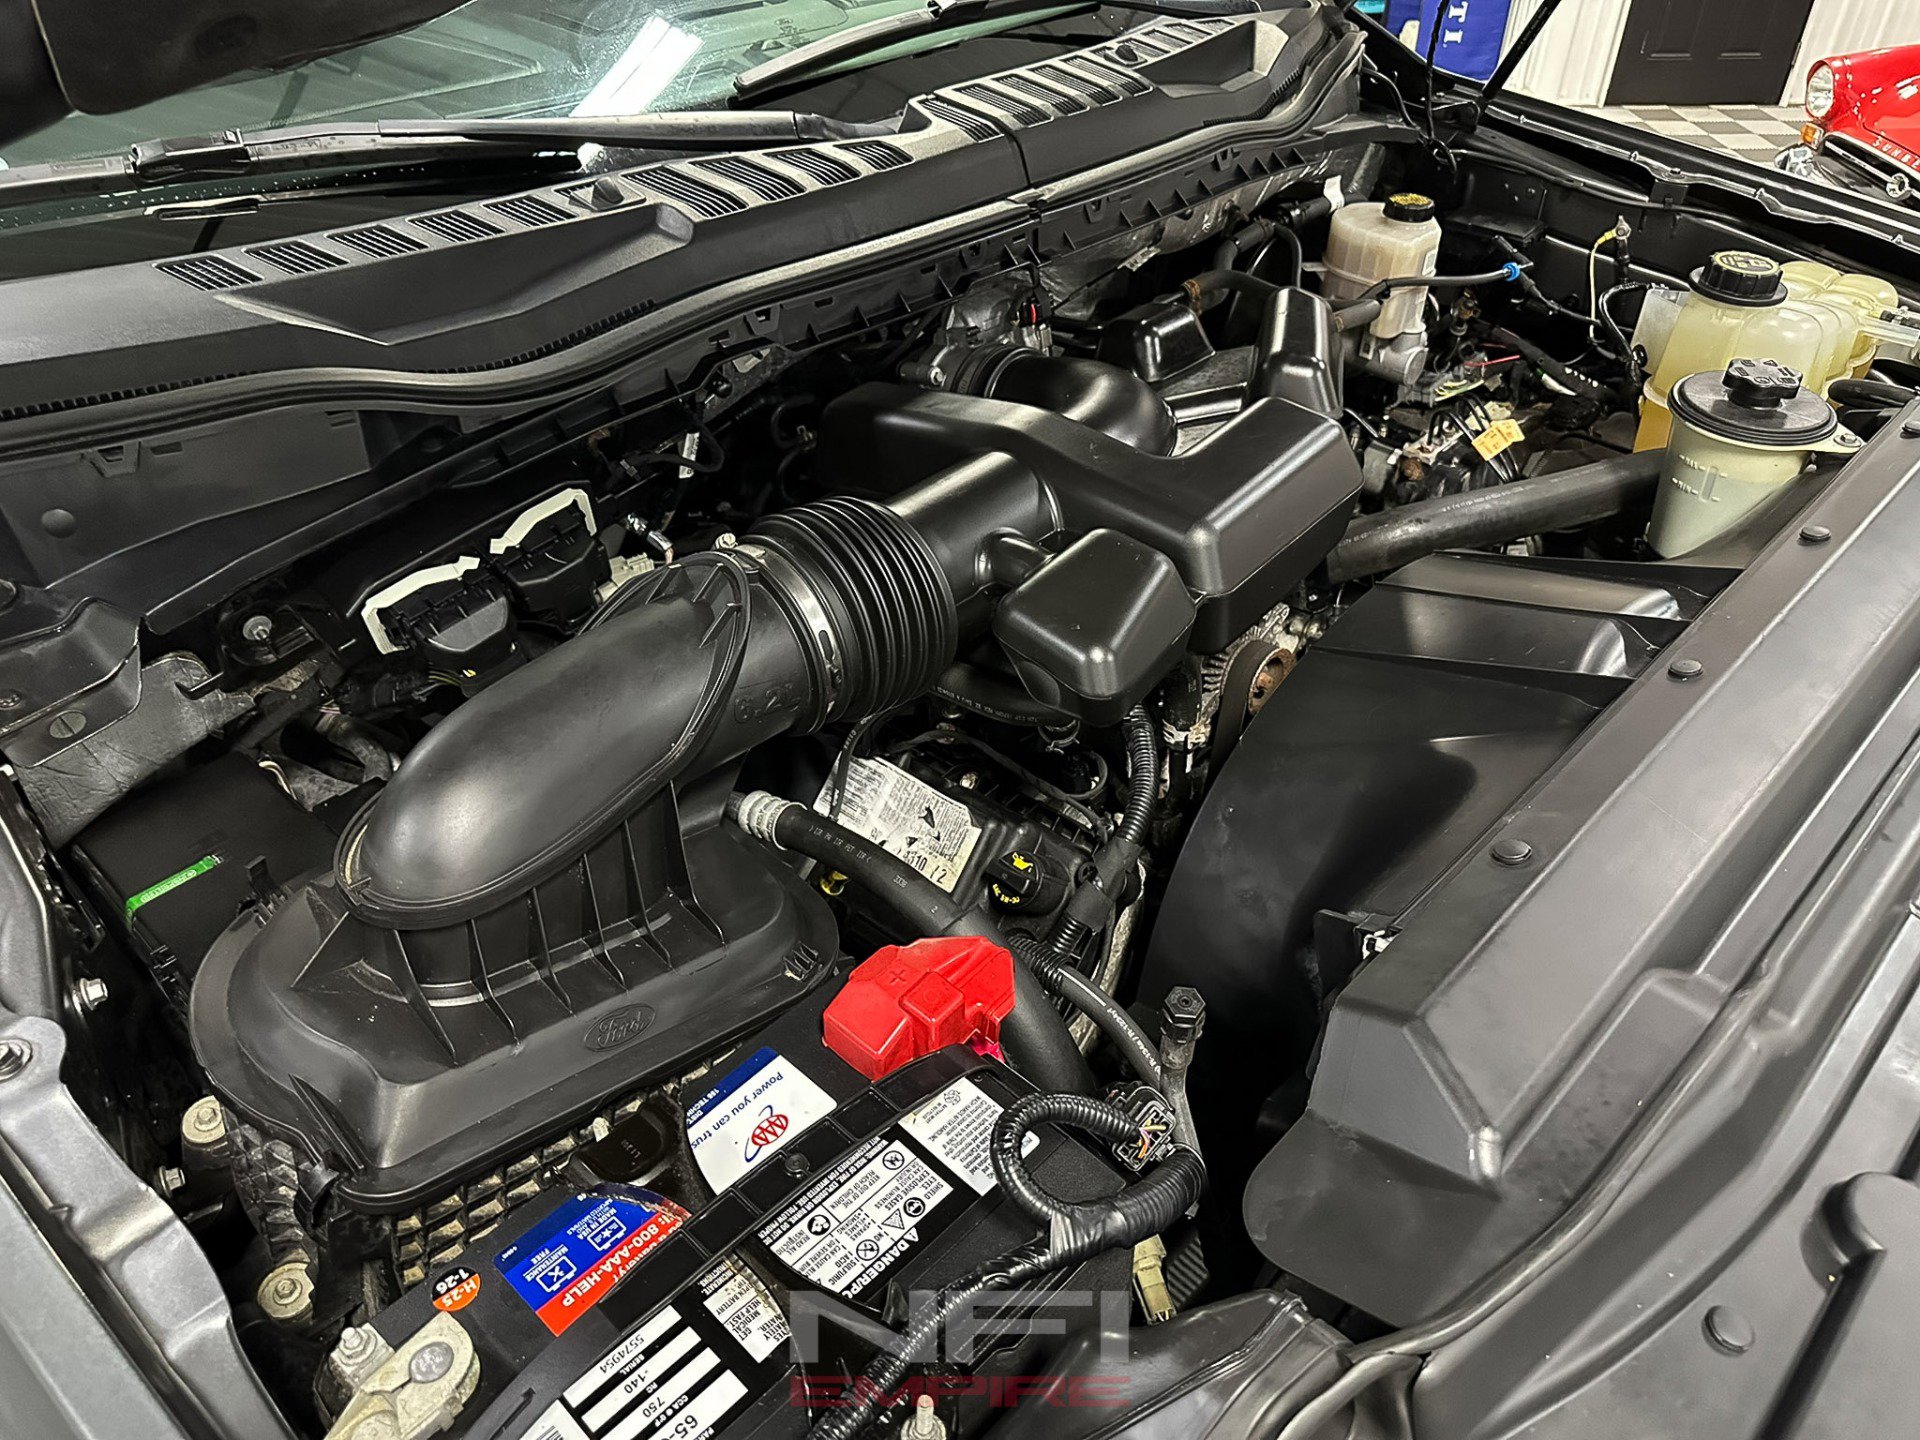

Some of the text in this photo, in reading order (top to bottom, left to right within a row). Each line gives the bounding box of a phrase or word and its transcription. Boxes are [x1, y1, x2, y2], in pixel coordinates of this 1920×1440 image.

[689, 1071, 783, 1150] Power you can trus
[748, 1113, 788, 1147] AAA
[874, 1165, 923, 1209] CAN CAUSE BLINDNESS
[884, 1169, 929, 1211] EXPLOSIVE GASES
[919, 1175, 935, 1191] EYES.
[923, 1181, 943, 1199] SHIELD
[829, 1187, 853, 1209] CHILDREN
[842, 1197, 853, 1208] THE
[576, 1206, 616, 1240] MADE IN USA
[873, 1231, 883, 1241] NO
[530, 1247, 550, 1264] FREE
[786, 1246, 796, 1255] ALL
[808, 1245, 827, 1263] SEVERE
[814, 1253, 830, 1268] CAUSE
[829, 1245, 840, 1255] CAN
[834, 1253, 849, 1267] ACID
[524, 1245, 568, 1281] MAINTENANCE
[559, 1222, 659, 1307] 800-AAA-HELP
[828, 1259, 856, 1285] SULFURIC
[434, 1266, 470, 1295] 1-26
[440, 1278, 477, 1307] H-25
[714, 1293, 739, 1315] BATTERY
[726, 1298, 761, 1328] HELP FAST.
[731, 1309, 760, 1333] MEDICAL
[737, 1327, 752, 1340] GET
[598, 1334, 644, 1373] 5574954
[619, 1353, 644, 1376] SERIAL
[645, 1381, 658, 1393] RC
[641, 1395, 665, 1418] 750
[671, 1394, 688, 1410] CCA
